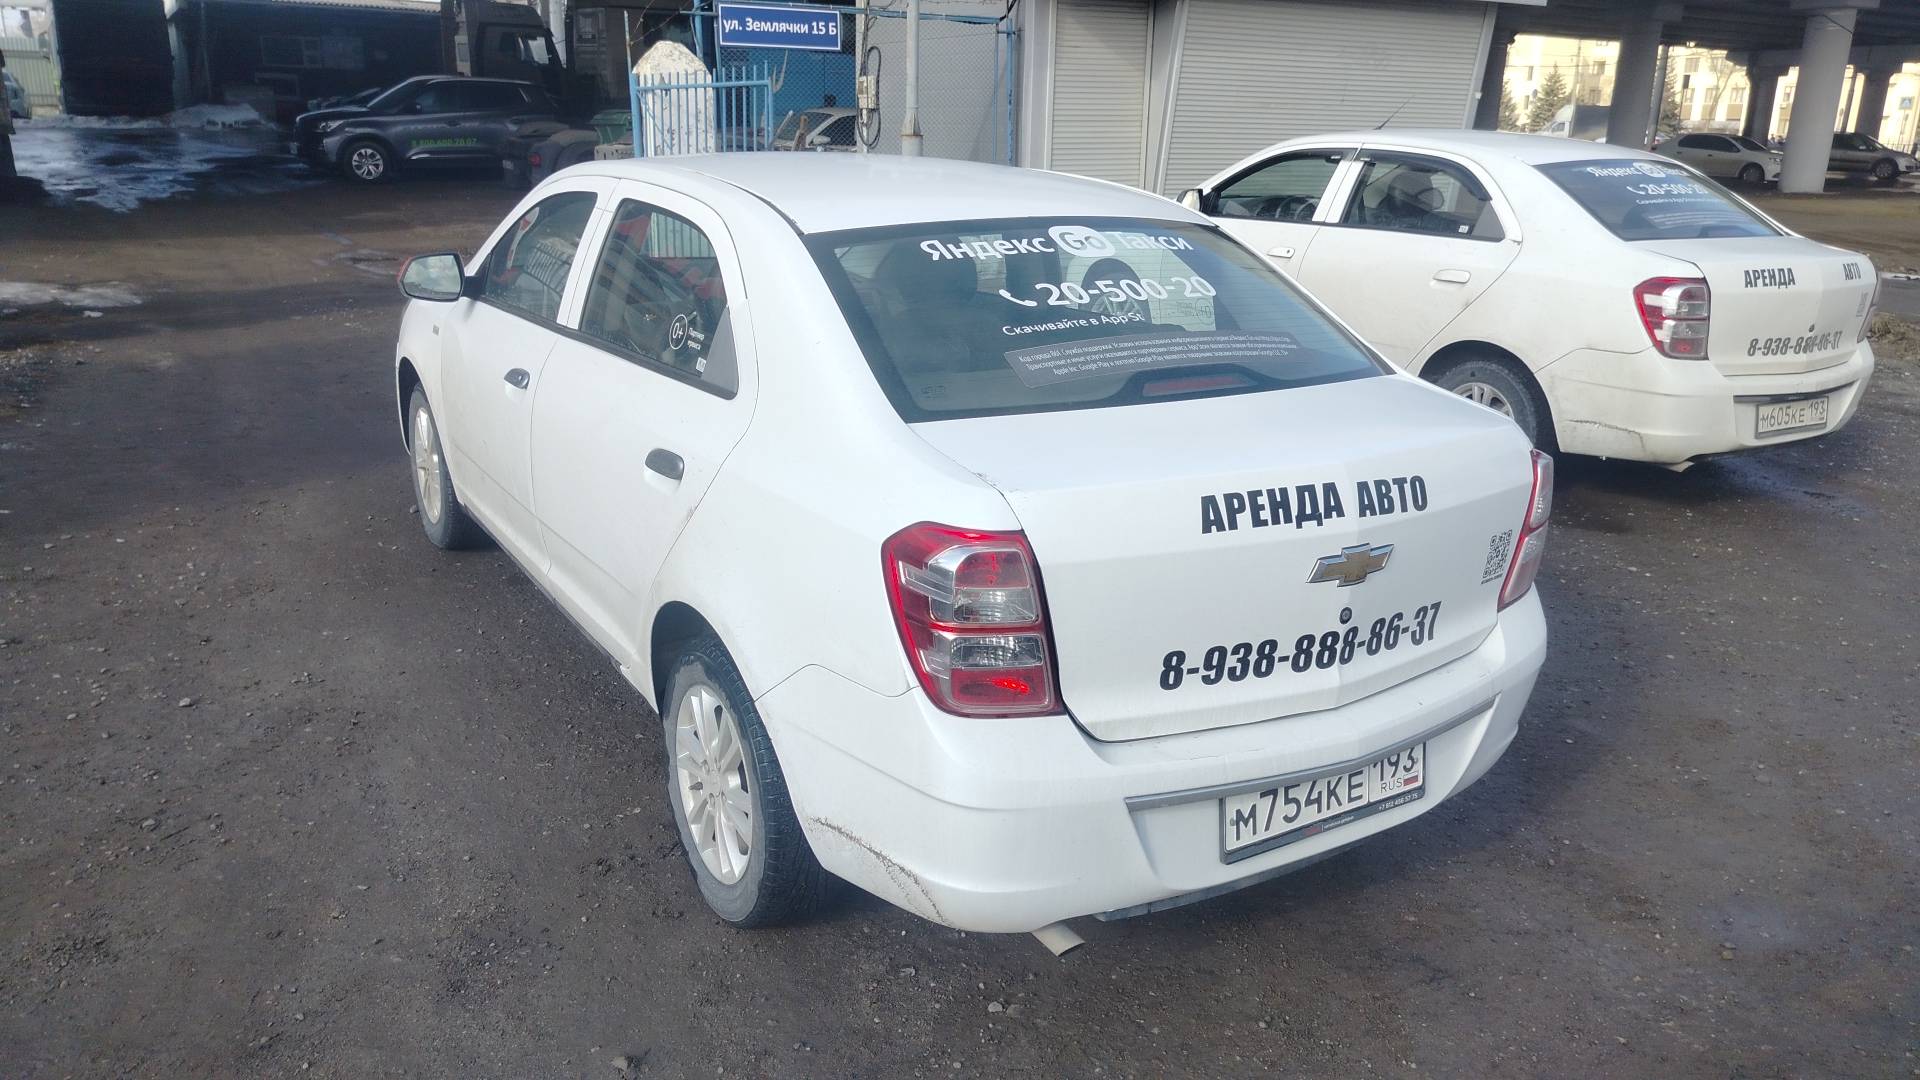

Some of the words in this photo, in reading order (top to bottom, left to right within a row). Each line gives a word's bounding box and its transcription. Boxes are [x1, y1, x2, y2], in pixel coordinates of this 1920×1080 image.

[723, 19, 742, 33] ул.
[745, 18, 808, 34] Землячки
[812, 21, 826, 35] 15
[828, 22, 837, 35] Б
[920, 236, 1055, 260] Яндекс
[1058, 230, 1106, 252] Go
[1113, 232, 1194, 251] Такси
[1744, 267, 1796, 289] АРЕНДА
[1843, 262, 1861, 281] АВТО
[1034, 275, 1217, 306] 20-500-20
[1002, 319, 1089, 336] Скачивайте
[1101, 315, 1128, 325] App
[1809, 399, 1826, 416] 193
[1200, 481, 1346, 534] АРЕНДА
[1356, 475, 1428, 518] АВТО
[1159, 600, 1442, 692] 8-938-888-86-37
[1380, 778, 1403, 794] RUS
